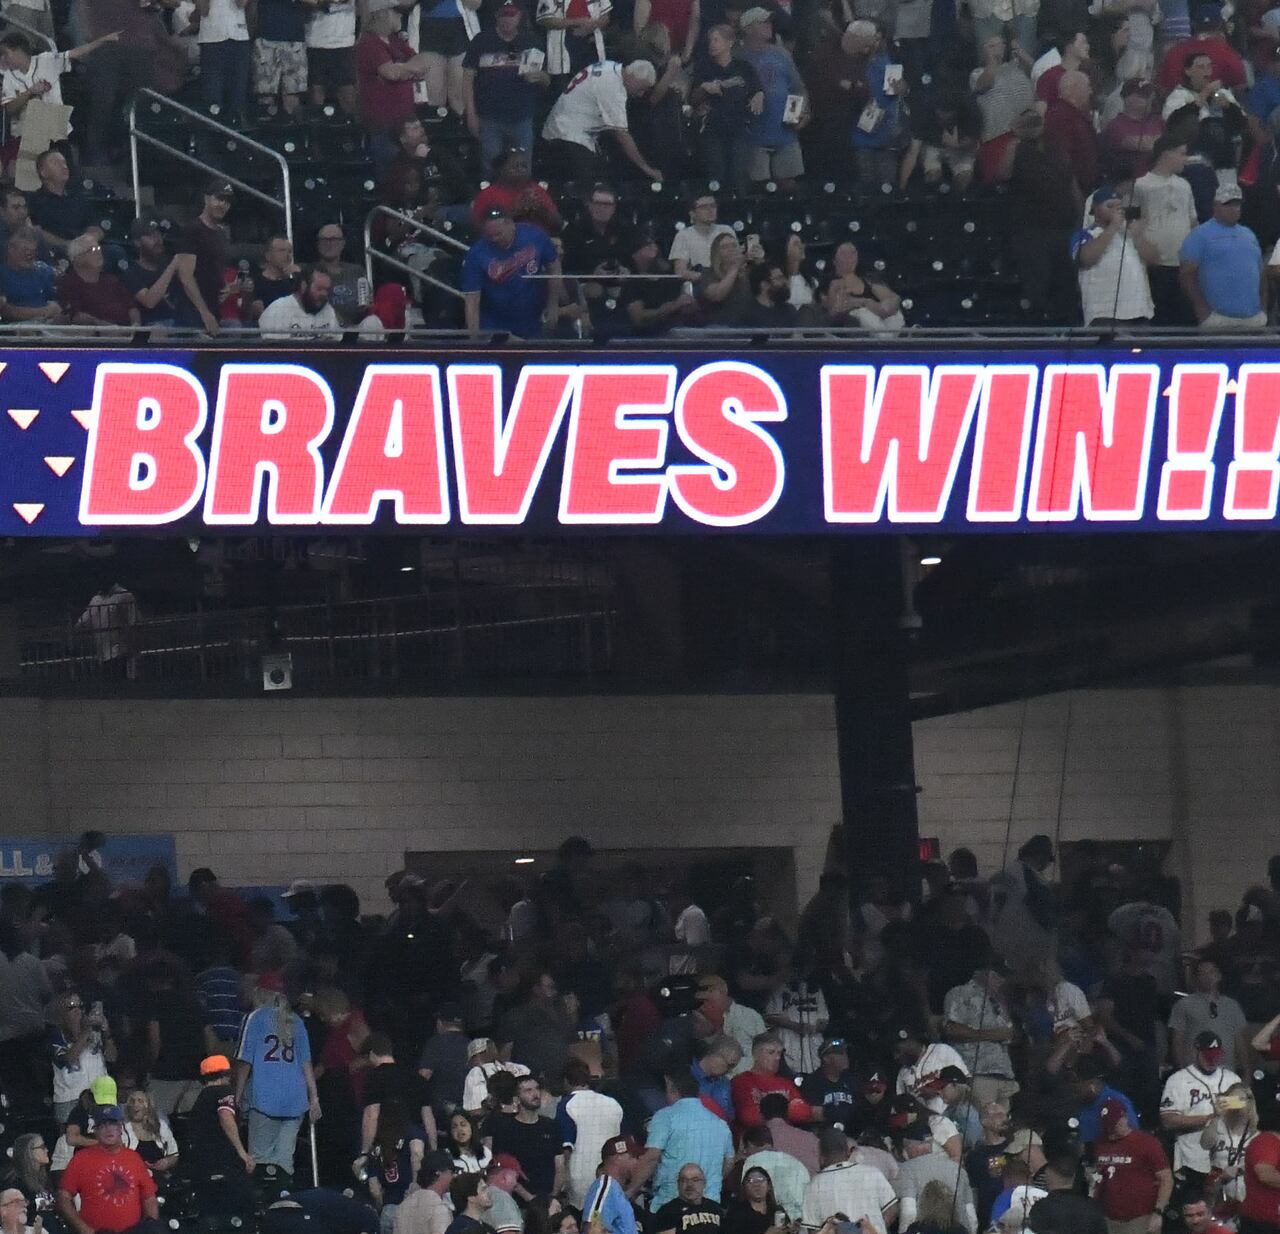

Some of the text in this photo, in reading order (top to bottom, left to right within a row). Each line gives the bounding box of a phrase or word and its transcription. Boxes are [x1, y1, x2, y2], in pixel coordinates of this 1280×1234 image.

[78, 362, 1280, 527] BRAVES WIN!!
[264, 1034, 295, 1063] 28
